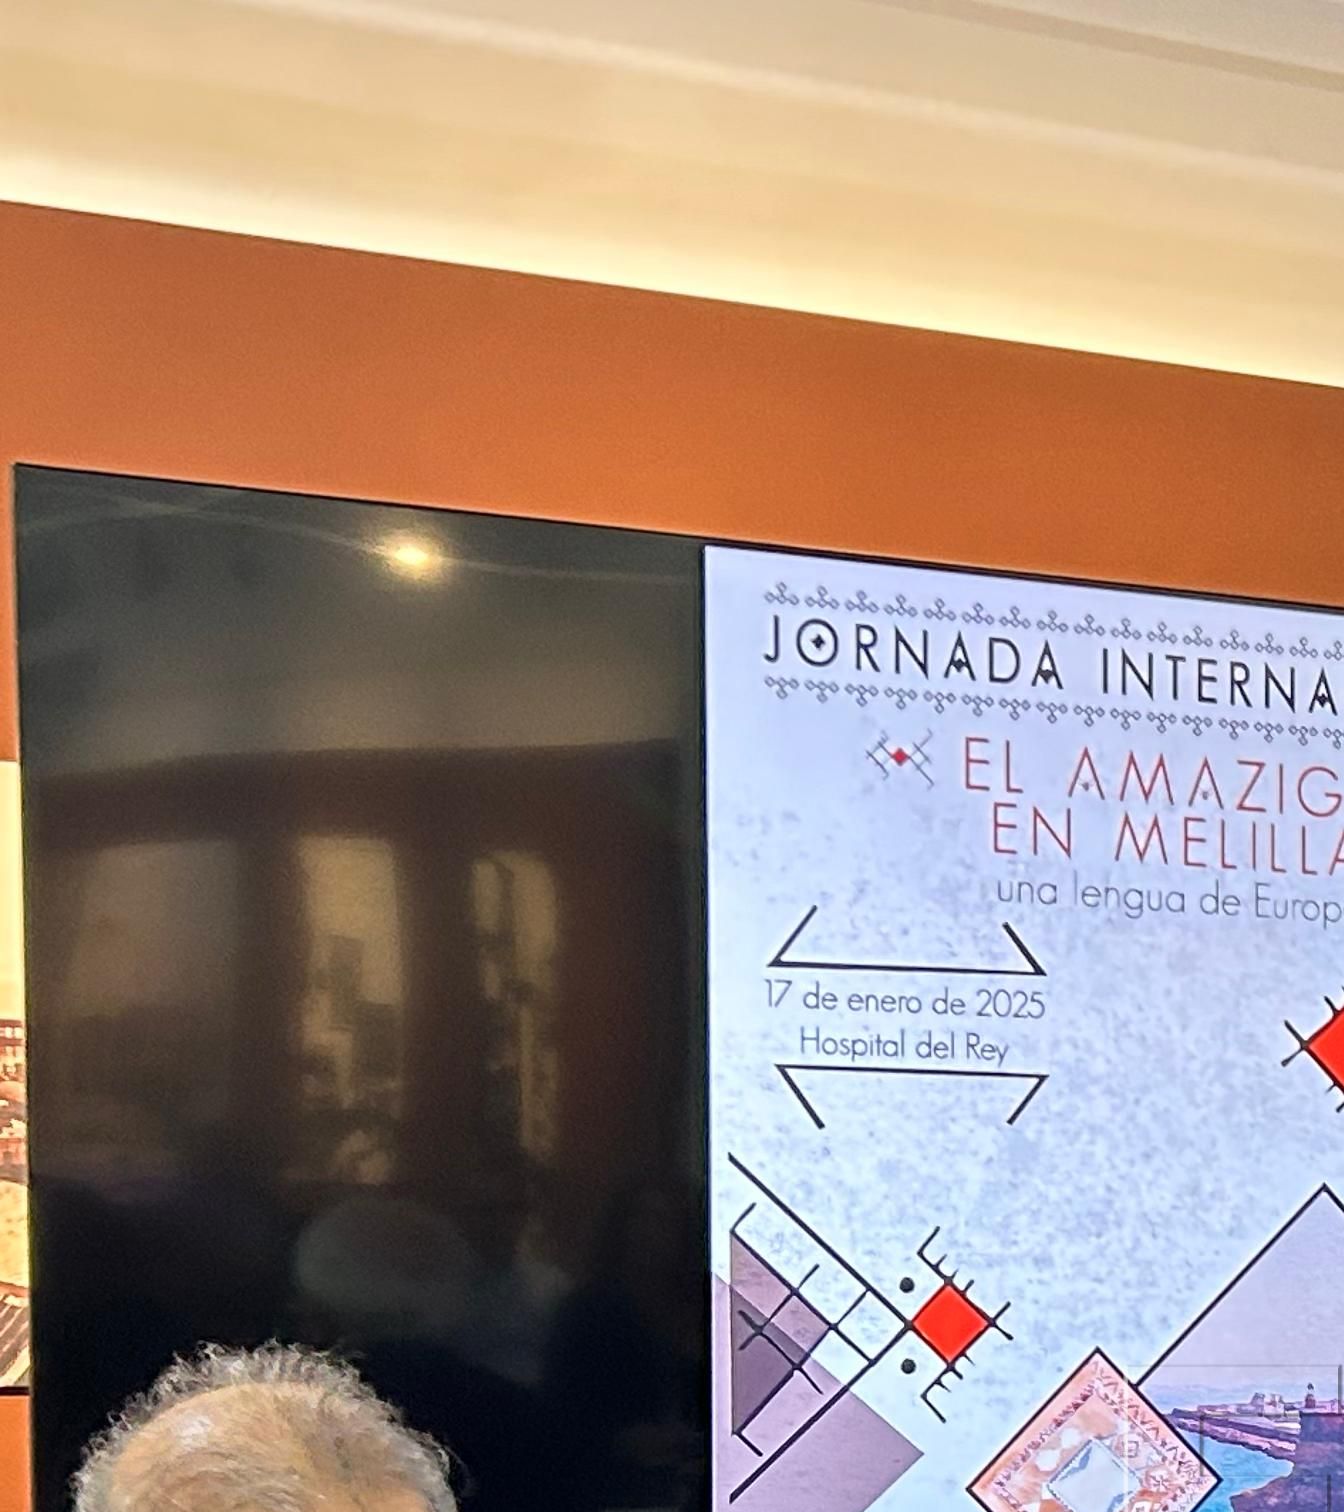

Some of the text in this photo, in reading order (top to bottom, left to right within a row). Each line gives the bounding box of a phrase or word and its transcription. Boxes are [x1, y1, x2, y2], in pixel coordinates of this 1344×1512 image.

[763, 615, 1064, 689] JORNADA
[963, 736, 1024, 796] EL
[991, 802, 1073, 859] EN
[997, 881, 1058, 905] una
[1073, 872, 1186, 919] lengua
[1200, 880, 1241, 915] de
[764, 978, 1046, 1020] 17 de enero de 2025
[800, 1025, 1008, 1066] Hospital del Rey
